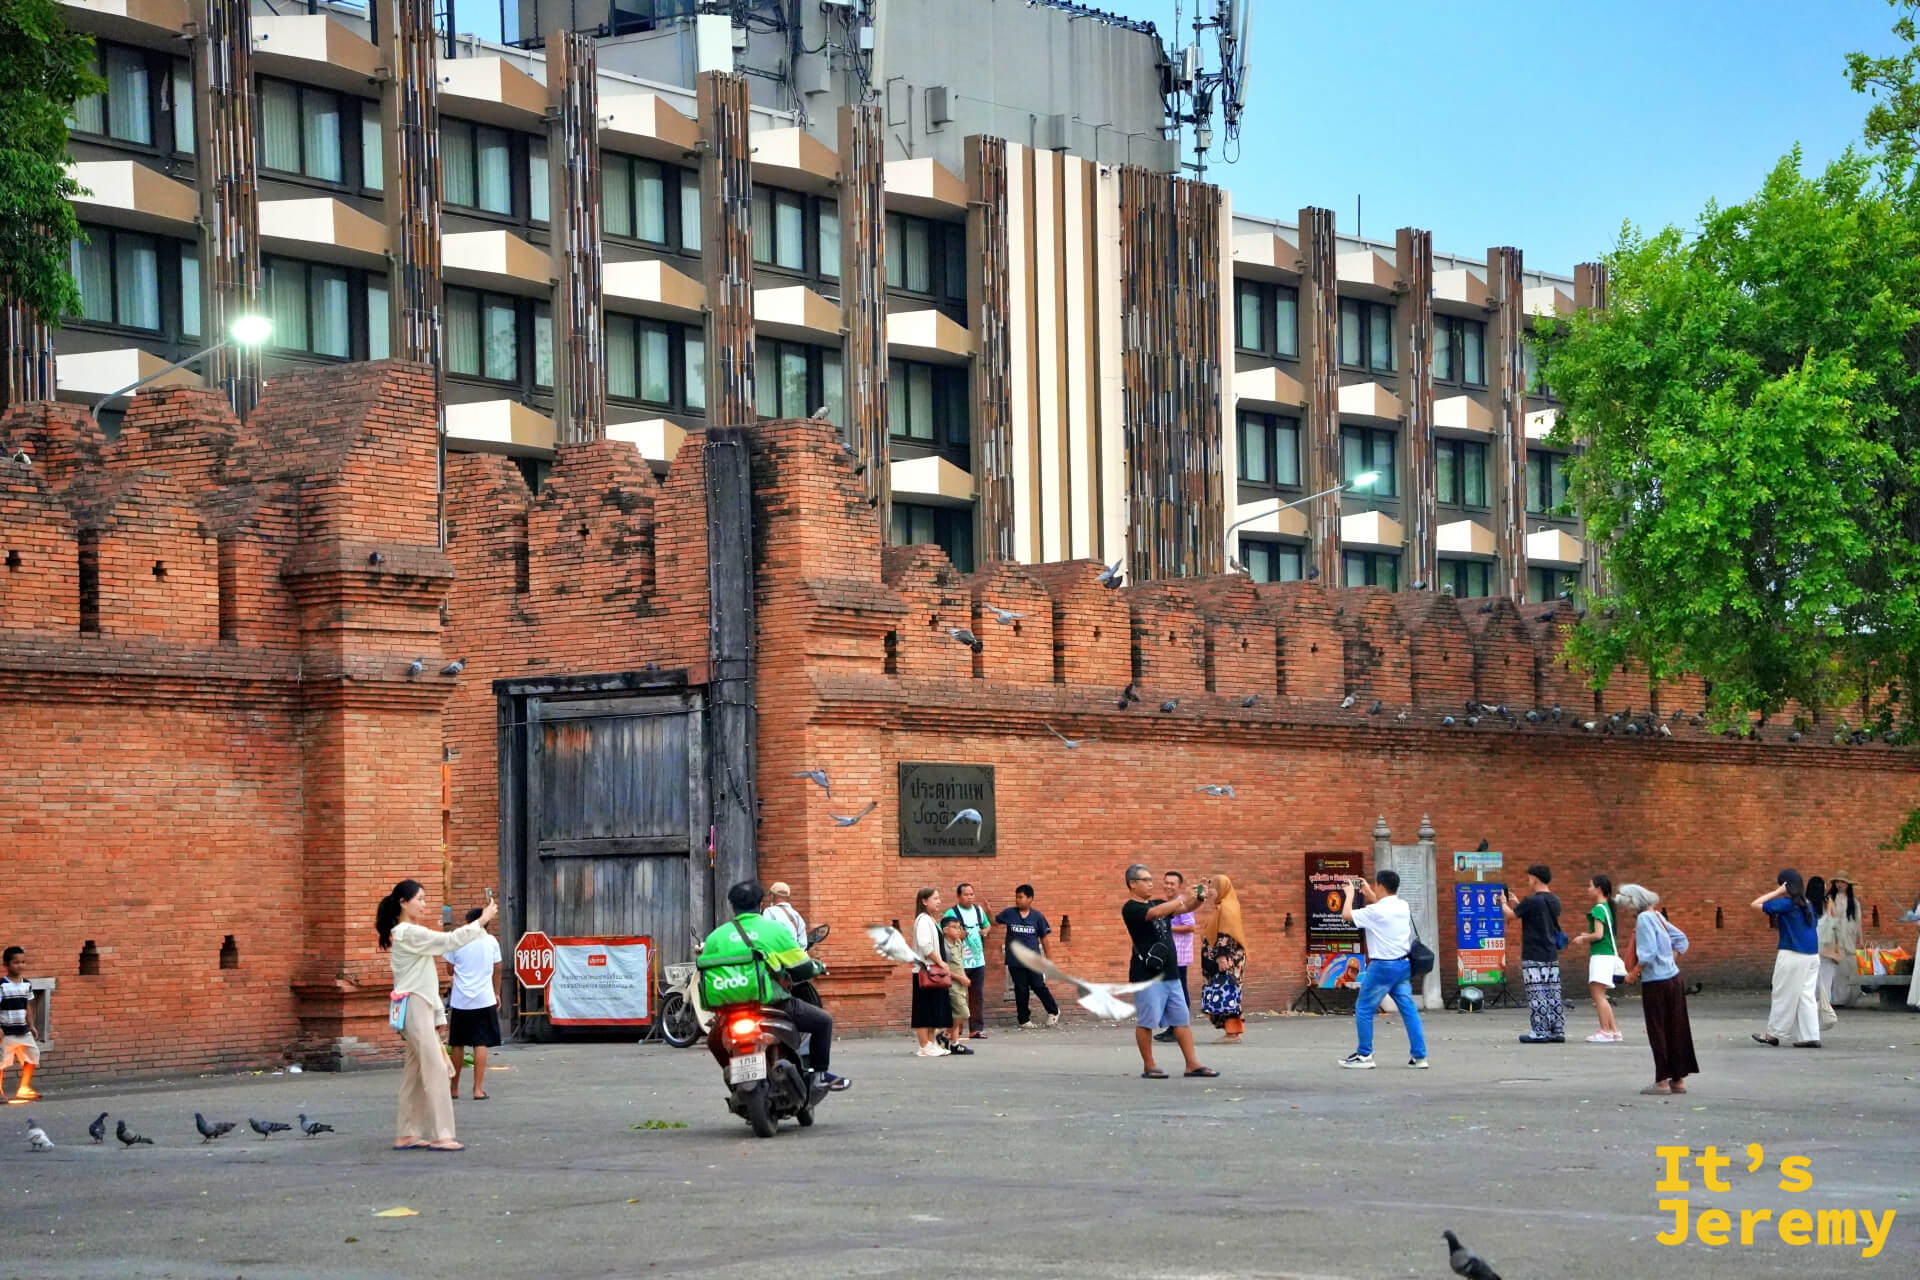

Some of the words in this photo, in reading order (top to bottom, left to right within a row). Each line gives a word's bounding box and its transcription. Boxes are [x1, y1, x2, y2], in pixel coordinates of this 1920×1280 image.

[911, 776, 984, 808] ประตูท่าแพ
[1486, 939, 1504, 949] 1155
[516, 949, 553, 981] หยุด
[713, 973, 749, 990] Grab
